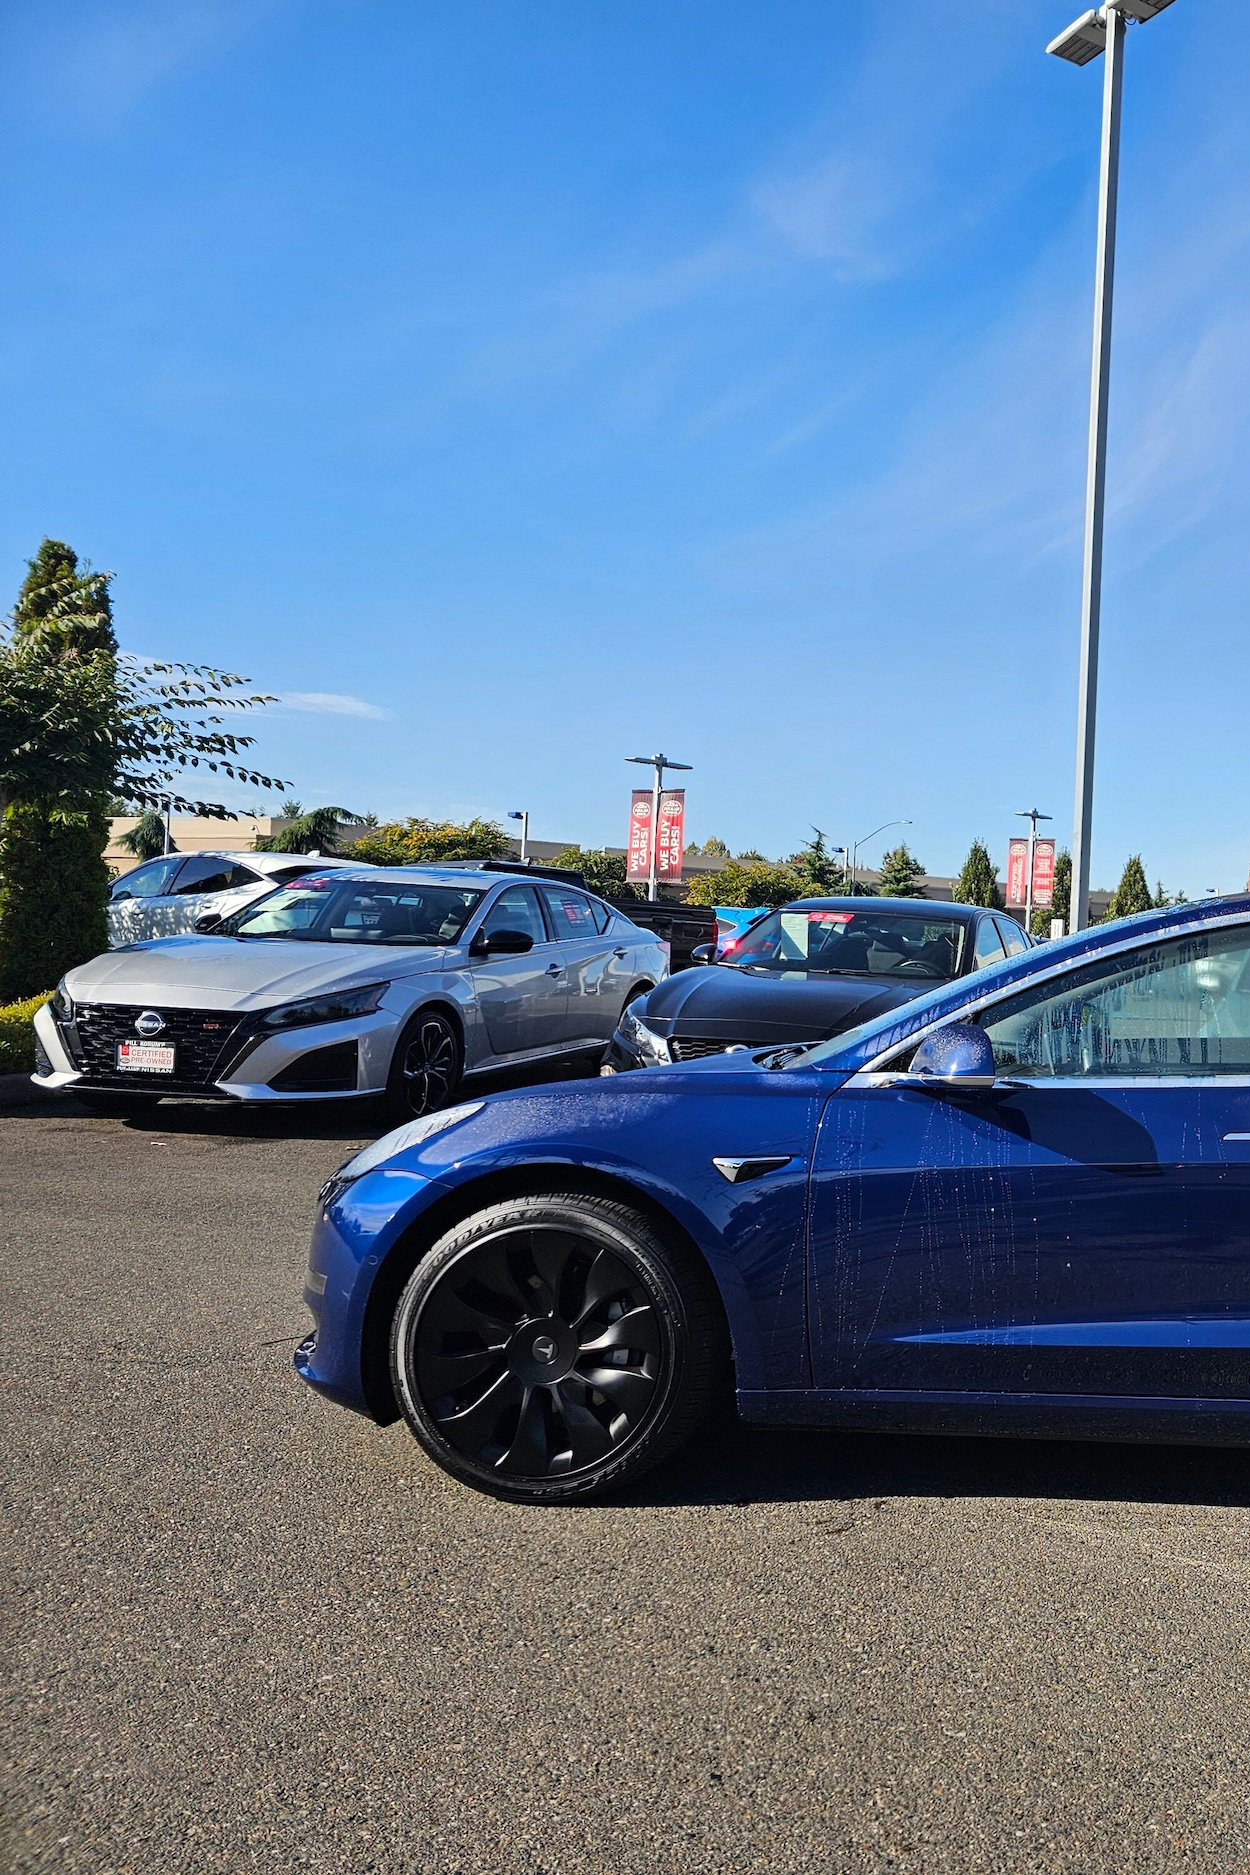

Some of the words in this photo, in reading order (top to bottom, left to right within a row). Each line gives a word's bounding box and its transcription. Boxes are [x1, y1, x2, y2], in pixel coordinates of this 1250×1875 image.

[631, 821, 641, 848] BUY
[660, 819, 670, 847] BUY
[639, 827, 648, 866] CARS!
[670, 825, 680, 865] CARS!
[630, 851, 639, 872] WE
[660, 849, 669, 871] WE
[135, 1020, 166, 1029] NISSAN
[130, 1057, 172, 1065] PRE-OWNED
[131, 1049, 172, 1058] CERTIFIED
